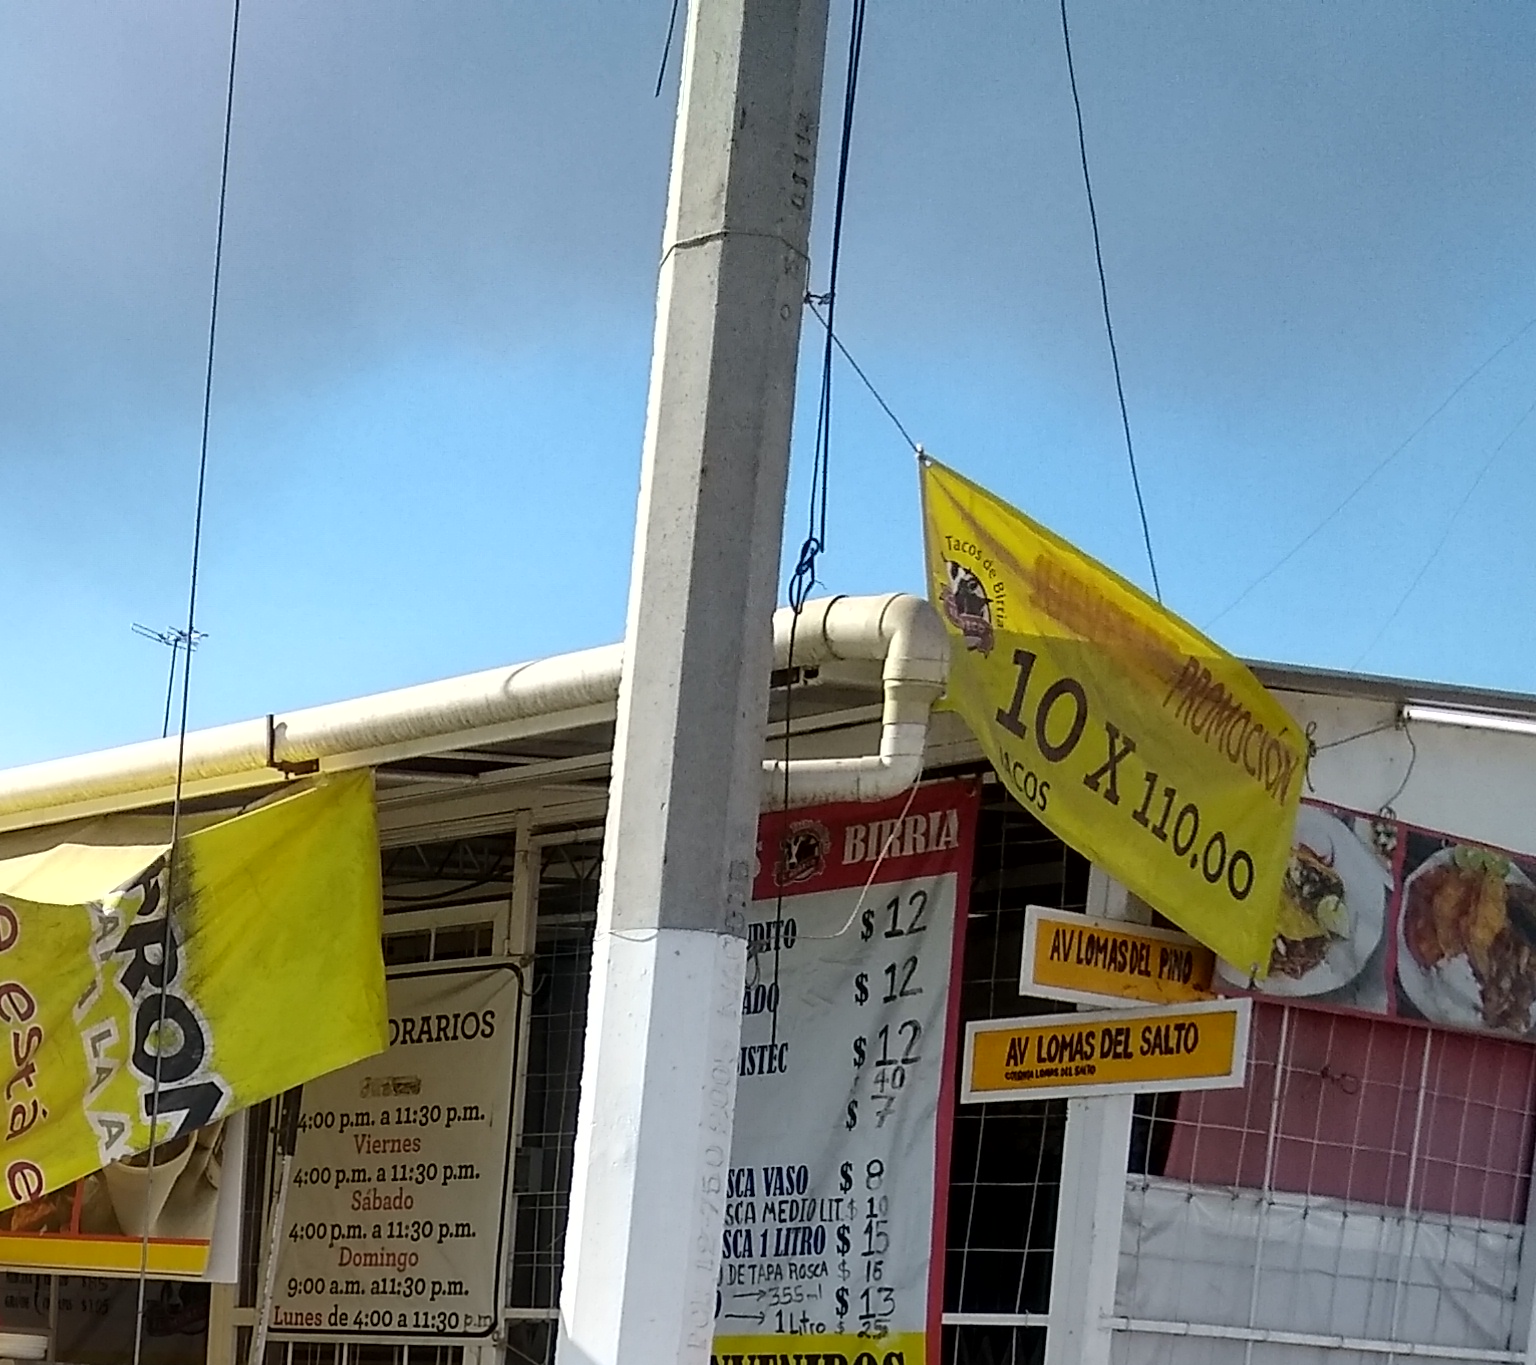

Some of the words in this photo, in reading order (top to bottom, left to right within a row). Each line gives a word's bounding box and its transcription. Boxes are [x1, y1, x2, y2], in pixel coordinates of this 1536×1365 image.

[945, 535, 982, 561] Tacos
[983, 559, 996, 579] de
[993, 582, 1008, 628] Birria
[1162, 655, 1300, 806] PROMOCIÓN
[995, 648, 1088, 762] 10
[1083, 721, 1136, 805] X
[1132, 772, 1255, 901] 110.00
[841, 808, 959, 865] BIRRIA
[861, 908, 875, 941] $
[884, 890, 928, 938] 12
[1049, 928, 1075, 961] AV
[1076, 930, 1127, 974] LOMAS
[1129, 943, 1152, 978] DEL
[1158, 950, 1193, 985] PINO
[742, 982, 779, 1015] ADO
[855, 972, 868, 1005] $
[882, 955, 923, 1003] 12
[388, 1010, 495, 1046] ORARIOS
[1005, 1036, 1029, 1067] AV
[1037, 1030, 1096, 1064] LOMAS
[1099, 1027, 1133, 1060] DEL
[1139, 1022, 1199, 1057] SALTO
[739, 1042, 789, 1076] ISTEC
[853, 1036, 867, 1068] $
[875, 1019, 922, 1066] 12
[1035, 1067, 1059, 1079] LOMAS
[1060, 1066, 1073, 1077] DEL
[1074, 1064, 1096, 1076] SALTO
[298, 1111, 335, 1133] 4:00
[338, 1112, 375, 1133] p.m.
[380, 1107, 391, 1126] a
[395, 1105, 441, 1127] 11:30
[445, 1105, 485, 1128] p.m.
[846, 1100, 859, 1131] $
[871, 1095, 896, 1130] 7
[354, 1134, 421, 1154] Viernes
[293, 1167, 331, 1188] 4:00
[334, 1167, 371, 1189] p.m.
[376, 1168, 387, 1183] a
[390, 1164, 438, 1184] 11:30
[442, 1163, 480, 1186] p.m.
[727, 1168, 755, 1198] SCA
[763, 1165, 809, 1197] VASO
[839, 1161, 853, 1194] $
[866, 1159, 884, 1190] 8
[351, 1187, 414, 1211] Sábado
[725, 1201, 756, 1226] SCA
[762, 1198, 817, 1223] MEDIO
[865, 1195, 889, 1219] 10
[288, 1223, 326, 1243] 4:00
[329, 1223, 367, 1248] p.m.
[372, 1225, 382, 1240] a
[387, 1221, 433, 1241] 11:30
[437, 1221, 476, 1243] p.m.
[723, 1228, 753, 1259] SCA
[759, 1228, 769, 1258] 1
[773, 1224, 826, 1257] LITRO
[836, 1224, 851, 1257] $
[861, 1218, 890, 1256] 15
[338, 1246, 419, 1272] Domingo
[747, 1263, 783, 1285] TAPA
[788, 1260, 829, 1281] ROSCA
[838, 1259, 851, 1281] $
[287, 1277, 325, 1297] 9:00
[330, 1280, 365, 1295] a.m.
[430, 1278, 469, 1301] p.m.
[835, 1286, 850, 1319] $
[859, 1286, 896, 1320] 13
[274, 1305, 322, 1327] Lunes
[328, 1304, 348, 1327] de
[353, 1310, 393, 1330] 4:00
[397, 1313, 407, 1328] a
[412, 1311, 459, 1332] 11:30
[775, 1309, 785, 1333] 1
[789, 1309, 826, 1336] Litro
